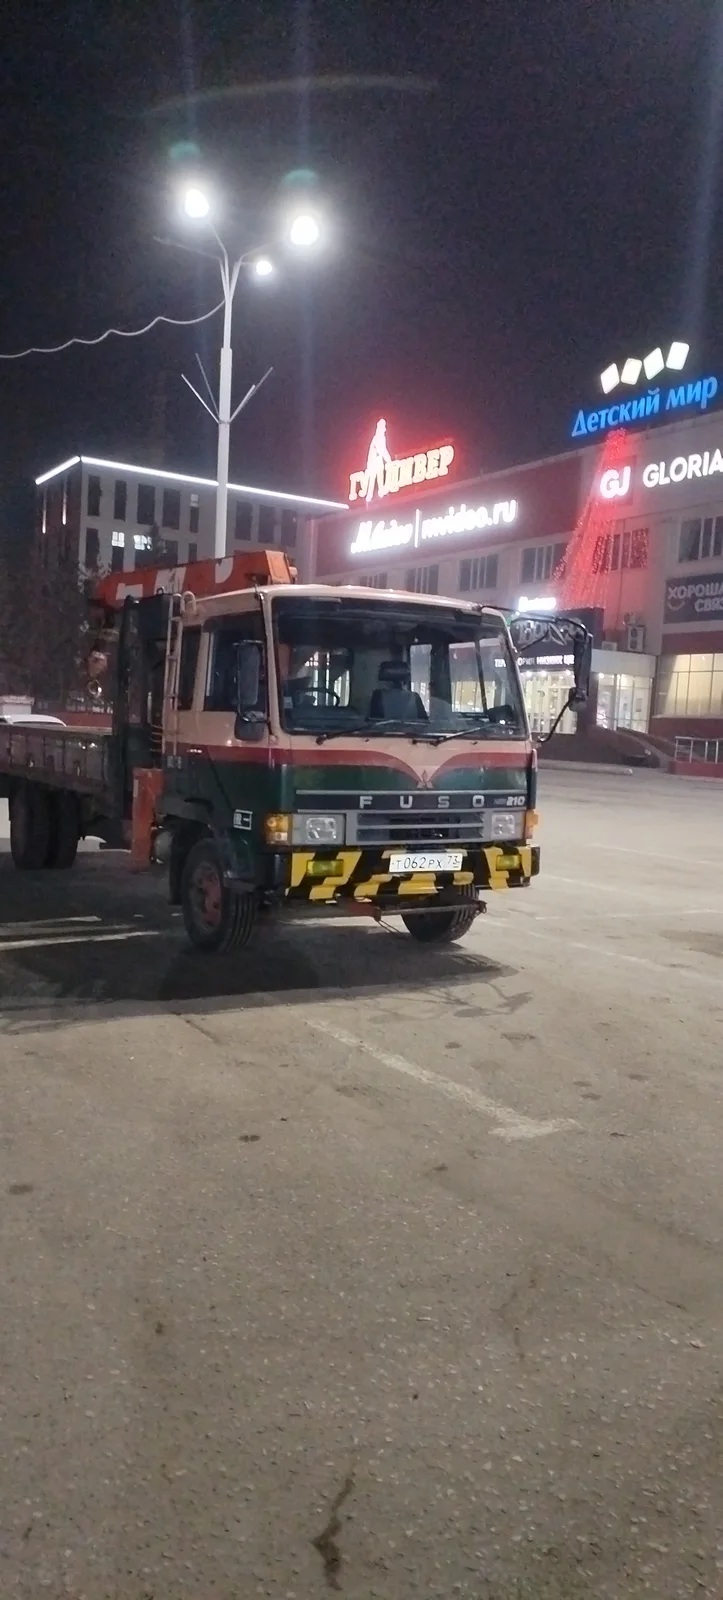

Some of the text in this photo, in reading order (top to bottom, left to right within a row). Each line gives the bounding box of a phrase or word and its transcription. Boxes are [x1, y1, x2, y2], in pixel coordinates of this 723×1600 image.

[571, 376, 718, 437] Детский мир
[600, 448, 723, 499] GJ GLORIA
[421, 499, 517, 540] mvideo.ru
[359, 795, 485, 809] FUSO
